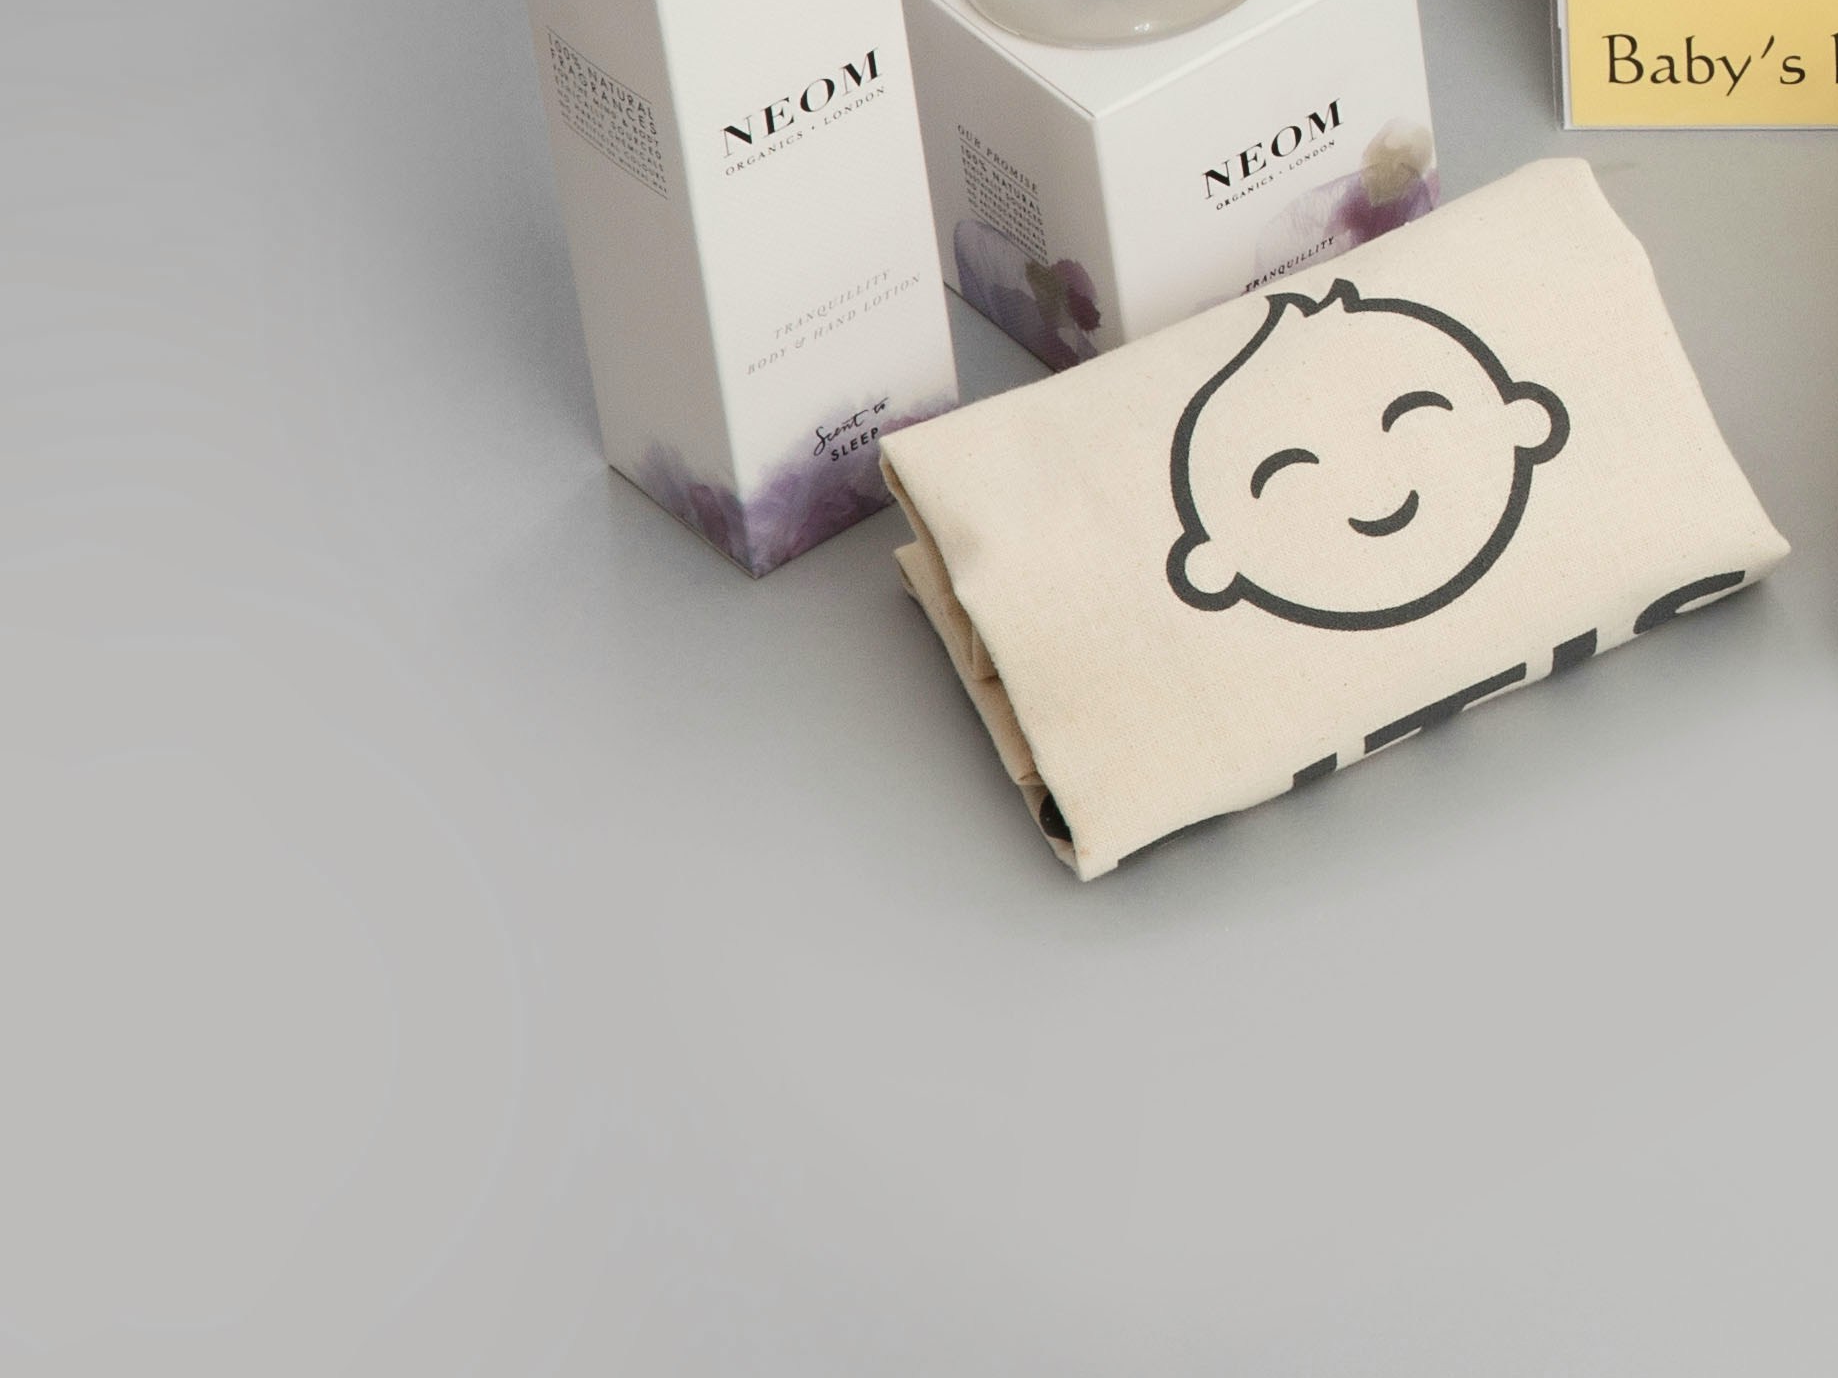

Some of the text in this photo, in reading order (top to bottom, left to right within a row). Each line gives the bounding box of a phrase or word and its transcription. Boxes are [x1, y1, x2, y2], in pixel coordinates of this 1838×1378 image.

[1603, 33, 1805, 97] Baby's
[720, 47, 883, 158] NEOM
[725, 86, 886, 176] ORGANICS LONDON
[1201, 98, 1343, 200] NEOM
[1216, 139, 1336, 211] ORGANICS LONDON
[1245, 235, 1334, 293] TRANQUILLITY
[747, 347, 787, 375] BODY
[814, 310, 856, 339] HAND
[864, 273, 921, 312] LOTION
[774, 268, 890, 339] TRANQUILLITY
[814, 409, 868, 456] Scent
[831, 427, 878, 461] SLEEP
